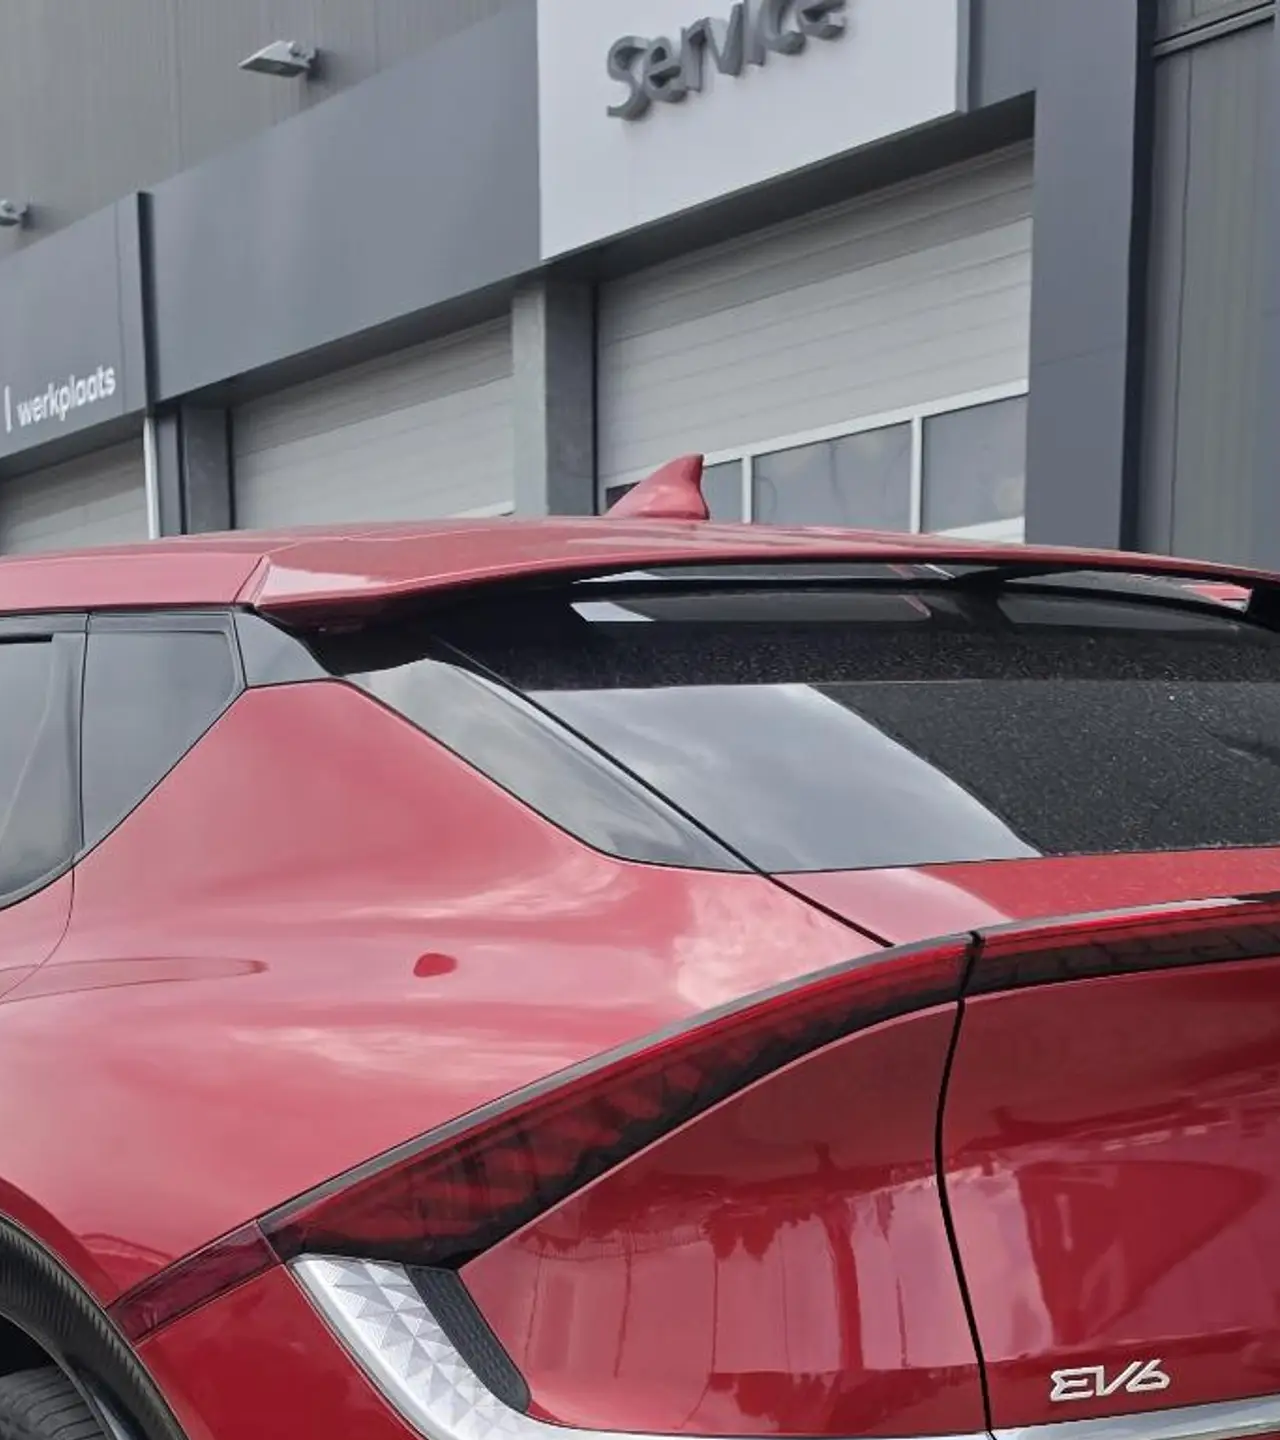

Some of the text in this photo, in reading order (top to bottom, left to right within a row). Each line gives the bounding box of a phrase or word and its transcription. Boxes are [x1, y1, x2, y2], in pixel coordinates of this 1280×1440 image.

[606, 0, 848, 121] Service
[16, 364, 116, 428] werkplaats
[1049, 1358, 1172, 1402] EV6
